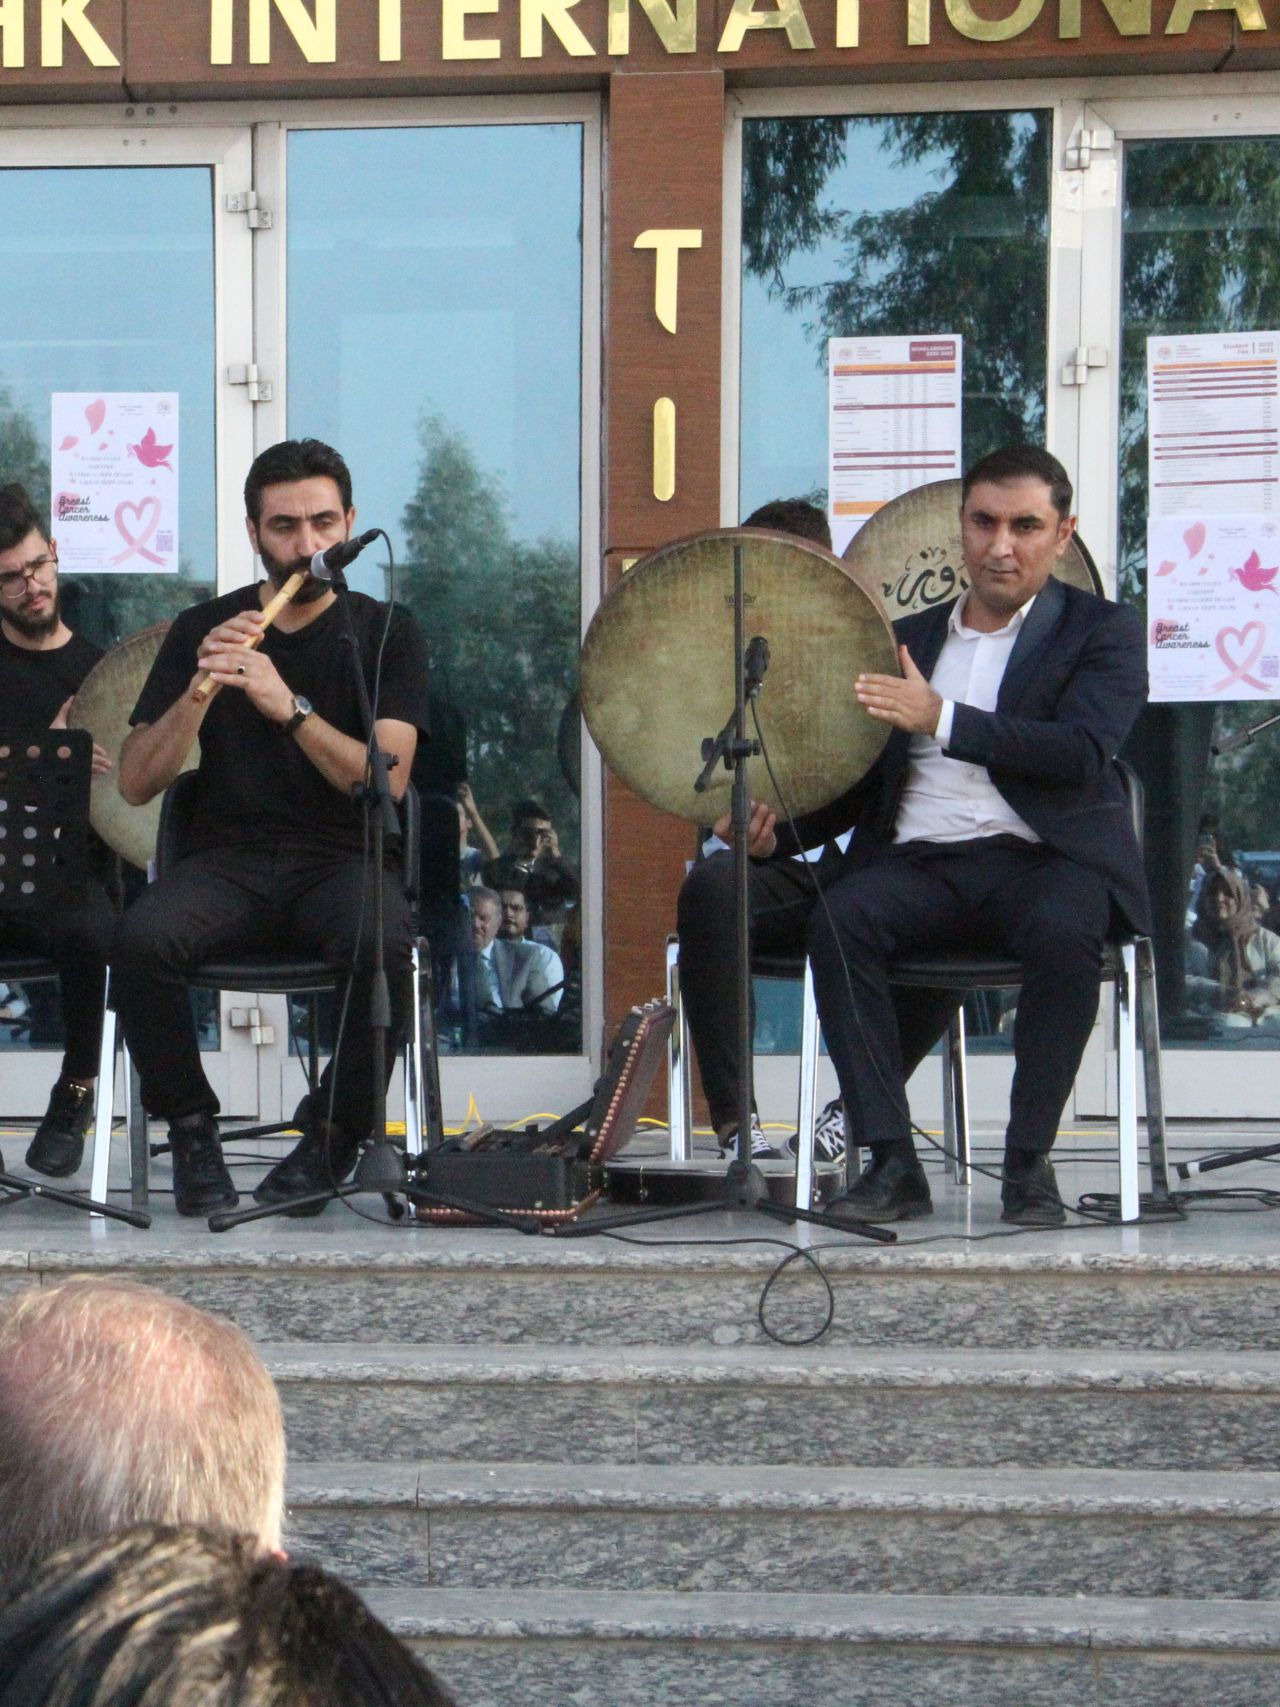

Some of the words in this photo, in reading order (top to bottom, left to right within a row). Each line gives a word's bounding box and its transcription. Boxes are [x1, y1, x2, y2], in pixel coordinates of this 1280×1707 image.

[58, 495, 91, 506] Breast
[58, 504, 90, 514] Cancer
[58, 512, 110, 521] Awareness
[1155, 622, 1189, 633] Breast
[1155, 632, 1189, 641] Cancer
[1155, 640, 1210, 649] Awareness
